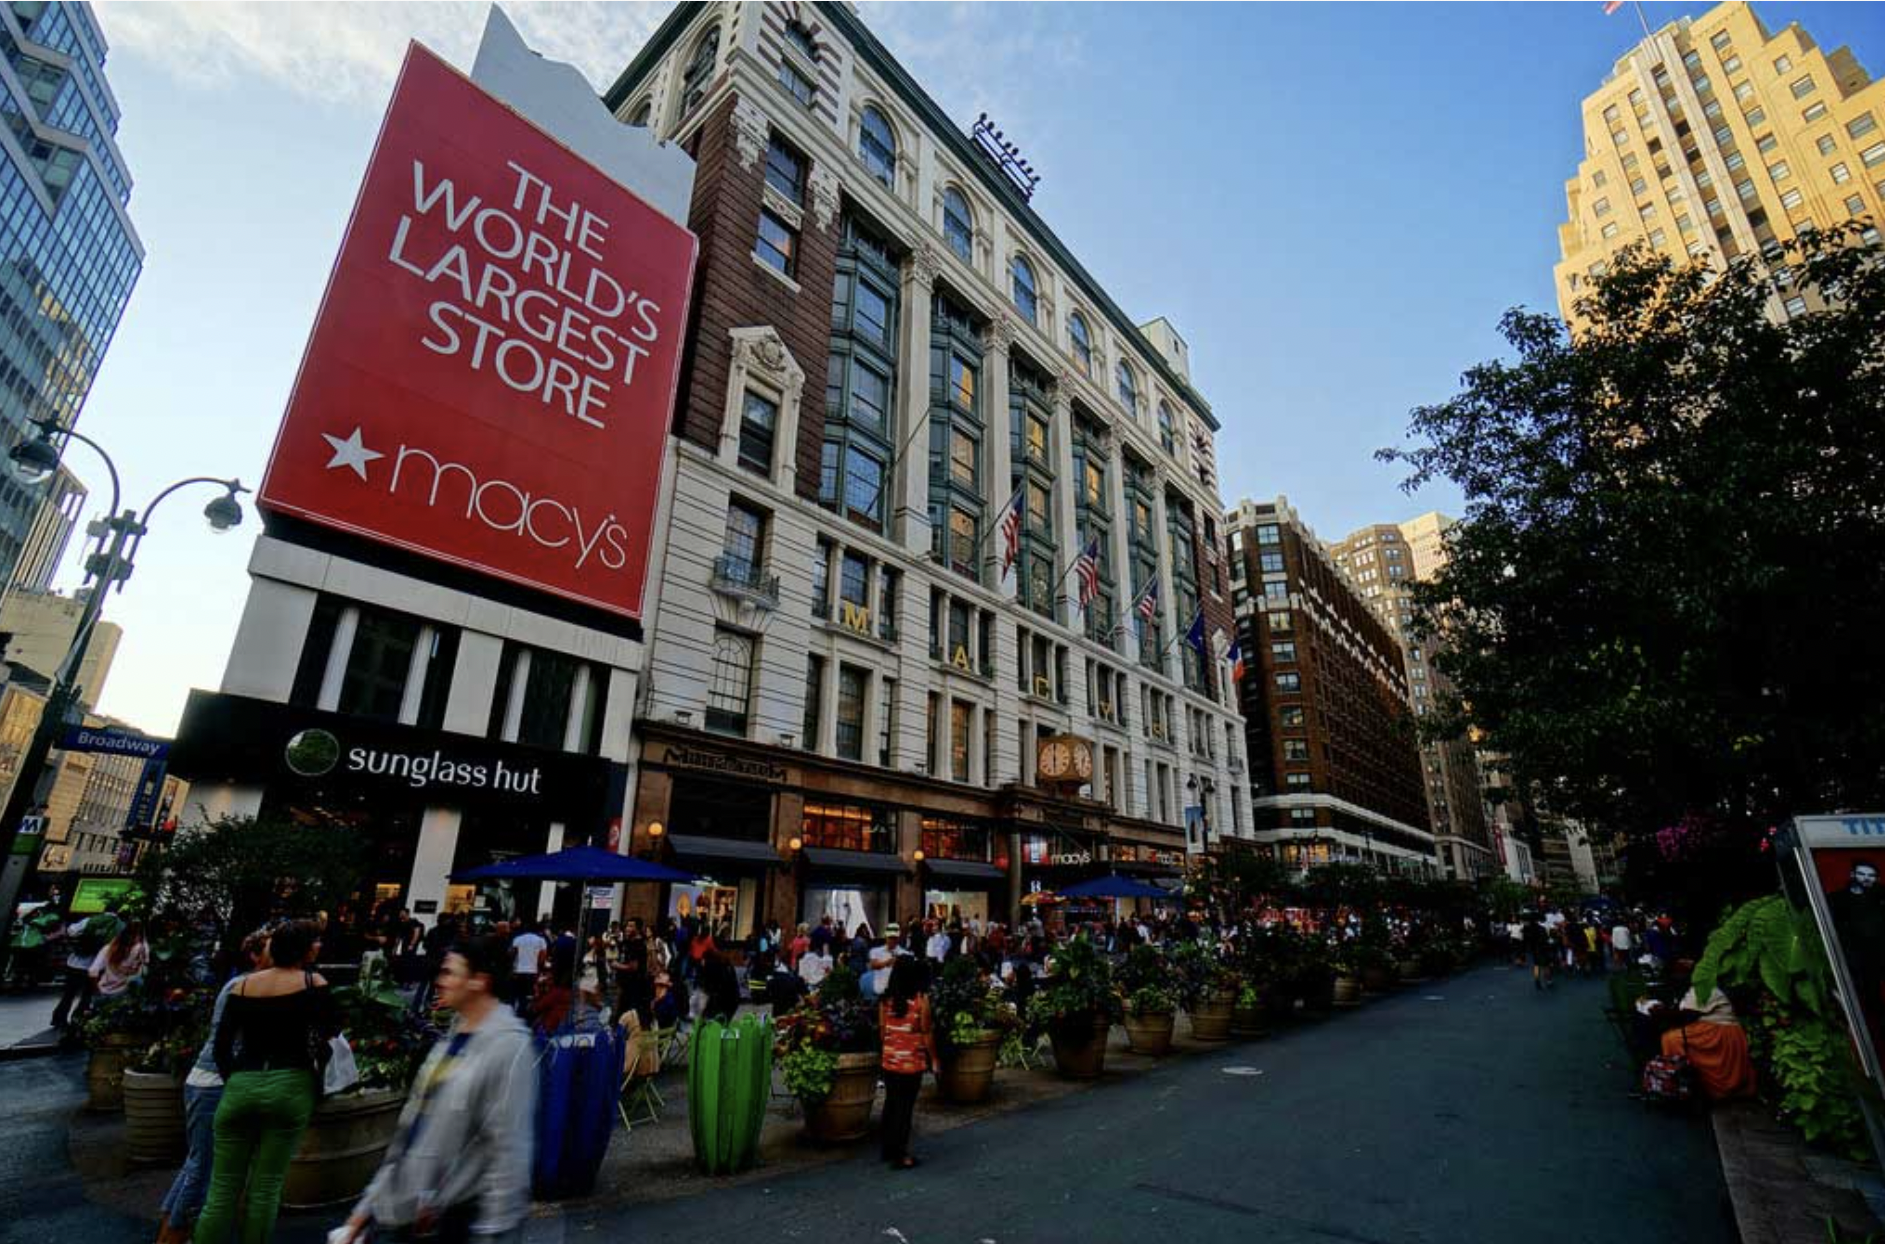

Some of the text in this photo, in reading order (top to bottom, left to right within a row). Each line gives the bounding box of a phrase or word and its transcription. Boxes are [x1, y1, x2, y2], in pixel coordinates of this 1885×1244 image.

[413, 159, 661, 343] WORLD'S
[506, 159, 610, 262] THE
[388, 213, 650, 386] LARGEST
[421, 300, 611, 430] STORE
[77, 731, 161, 757] Broadway
[348, 748, 542, 795] sunglass hut
